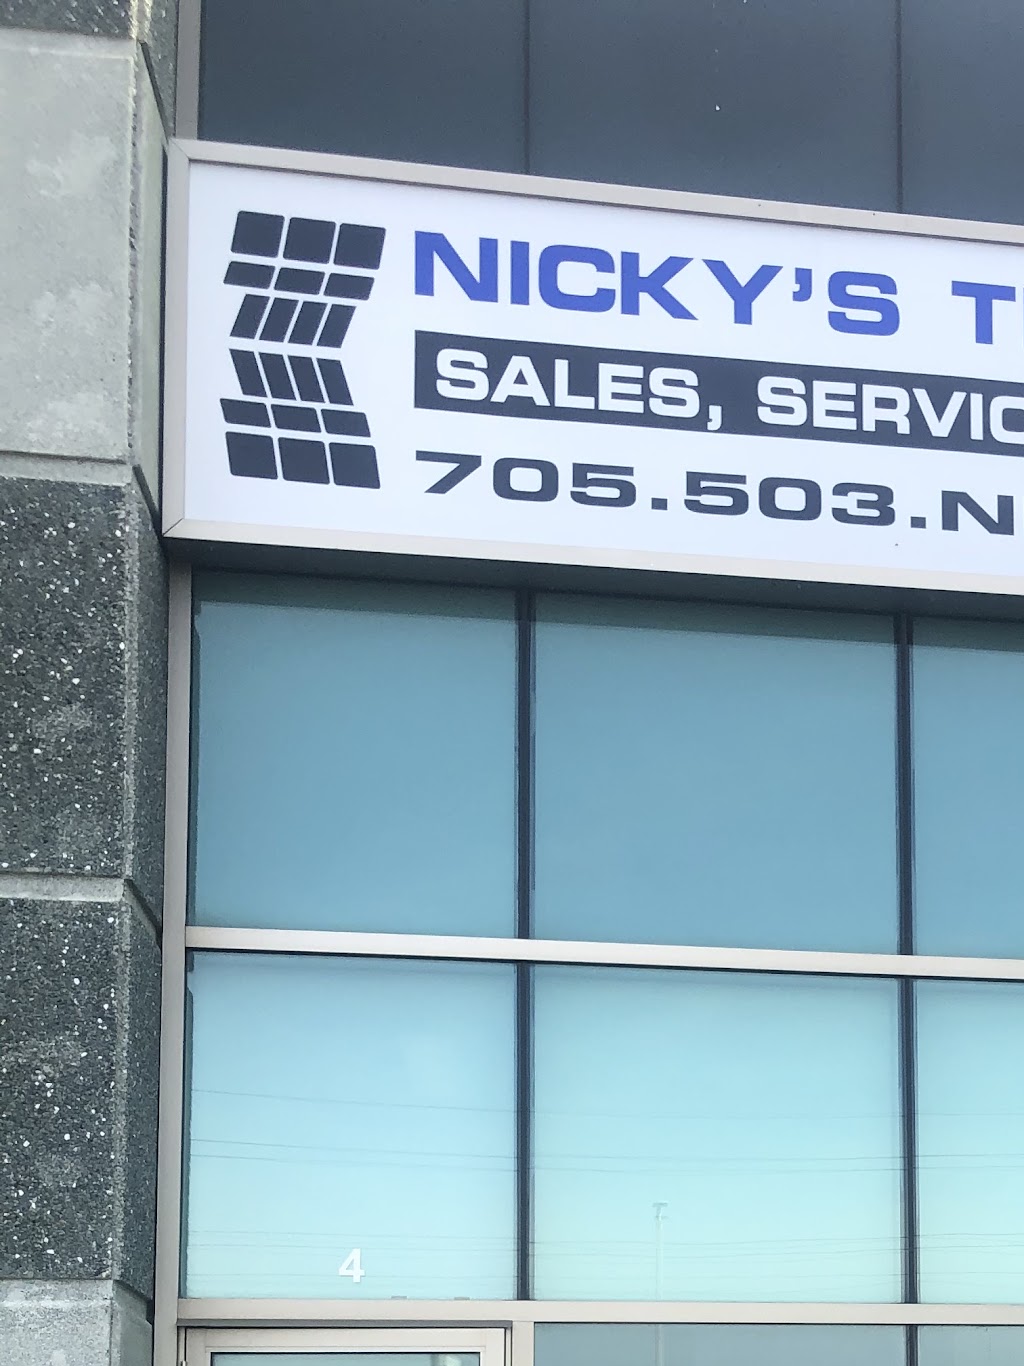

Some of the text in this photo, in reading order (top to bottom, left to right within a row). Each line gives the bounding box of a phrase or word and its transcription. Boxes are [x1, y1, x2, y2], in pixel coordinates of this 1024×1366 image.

[414, 230, 901, 337] NICKY'S
[435, 347, 723, 432] SALES,
[338, 1248, 366, 1283] 4
